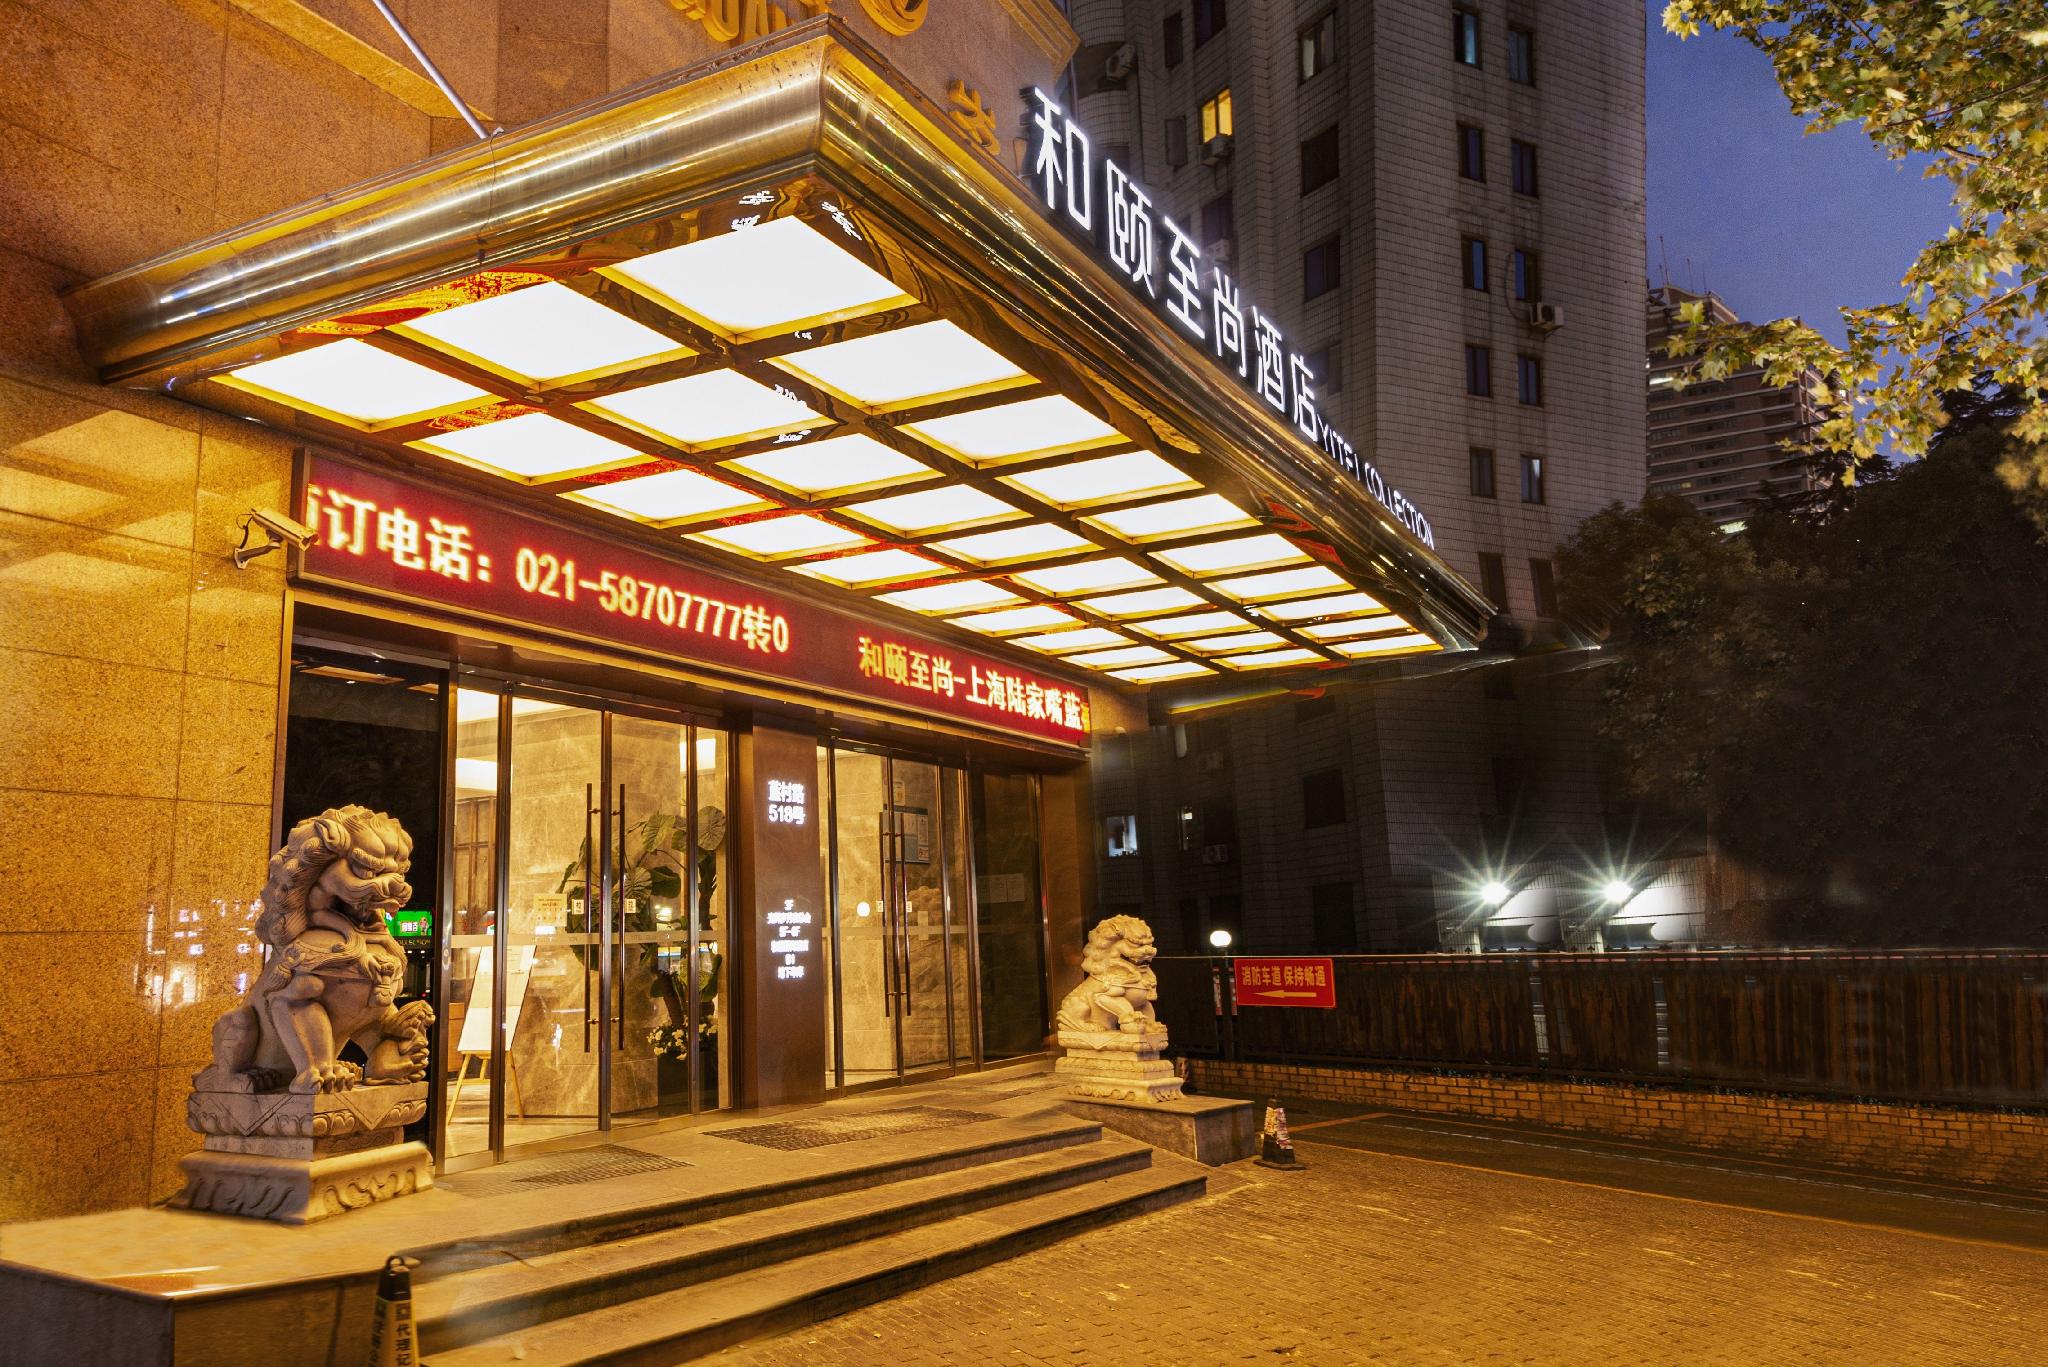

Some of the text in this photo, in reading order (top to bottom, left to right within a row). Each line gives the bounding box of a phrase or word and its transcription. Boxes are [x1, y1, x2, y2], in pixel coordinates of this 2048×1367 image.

[1035, 87, 1318, 442] 和颐至尚酒店
[1364, 462, 1435, 551] COLLECTION
[857, 636, 1090, 734] 和颐至尚-上海陆家嘴蓝
[768, 804, 806, 825] 518号
[1241, 965, 1326, 987] 消防车道 保持畅通
